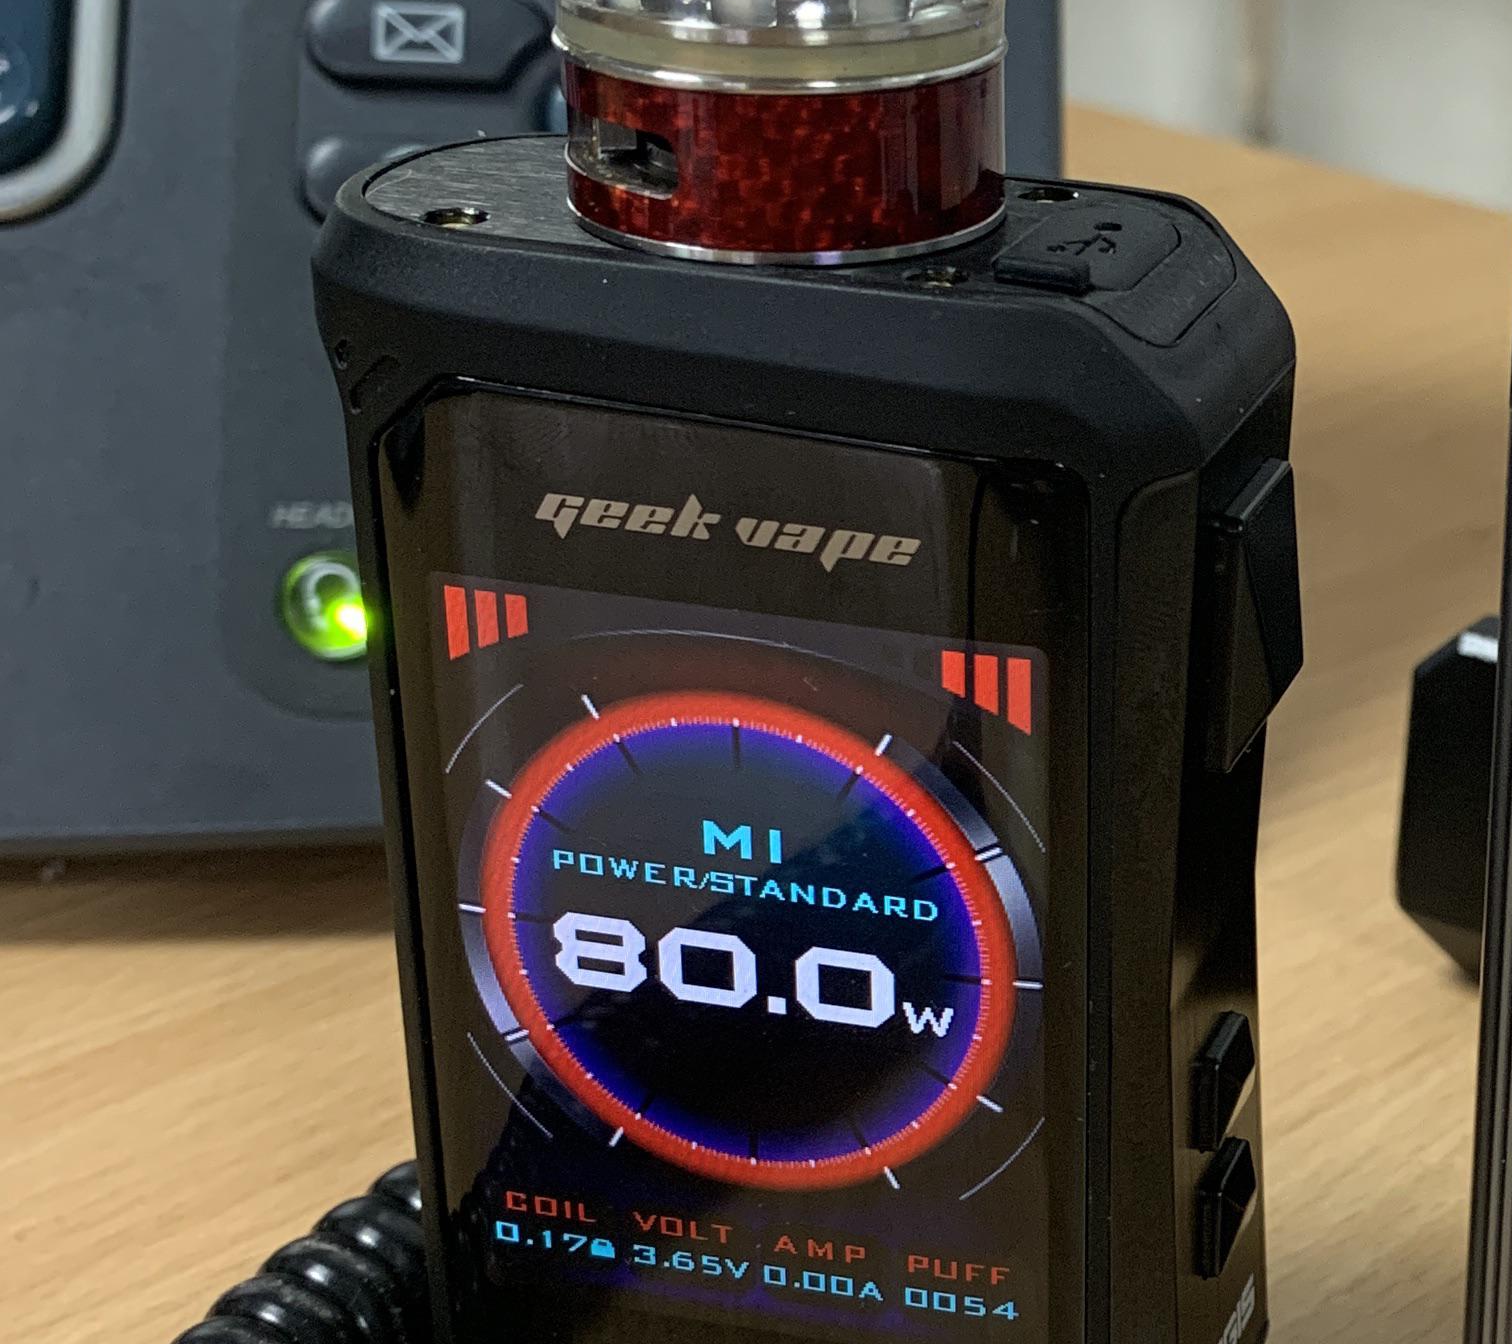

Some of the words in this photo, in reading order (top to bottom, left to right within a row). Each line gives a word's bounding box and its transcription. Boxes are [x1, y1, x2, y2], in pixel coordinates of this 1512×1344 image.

[552, 848, 939, 922] POWER/STANDARD
[504, 1190, 597, 1223] COIL
[632, 1211, 733, 1244] VOLT
[773, 1234, 866, 1264] AMP
[907, 1254, 1010, 1286] PUFF
[632, 1243, 750, 1280] 3.65V
[763, 1264, 884, 1302] 0.00A
[904, 1287, 1019, 1321] 0054
